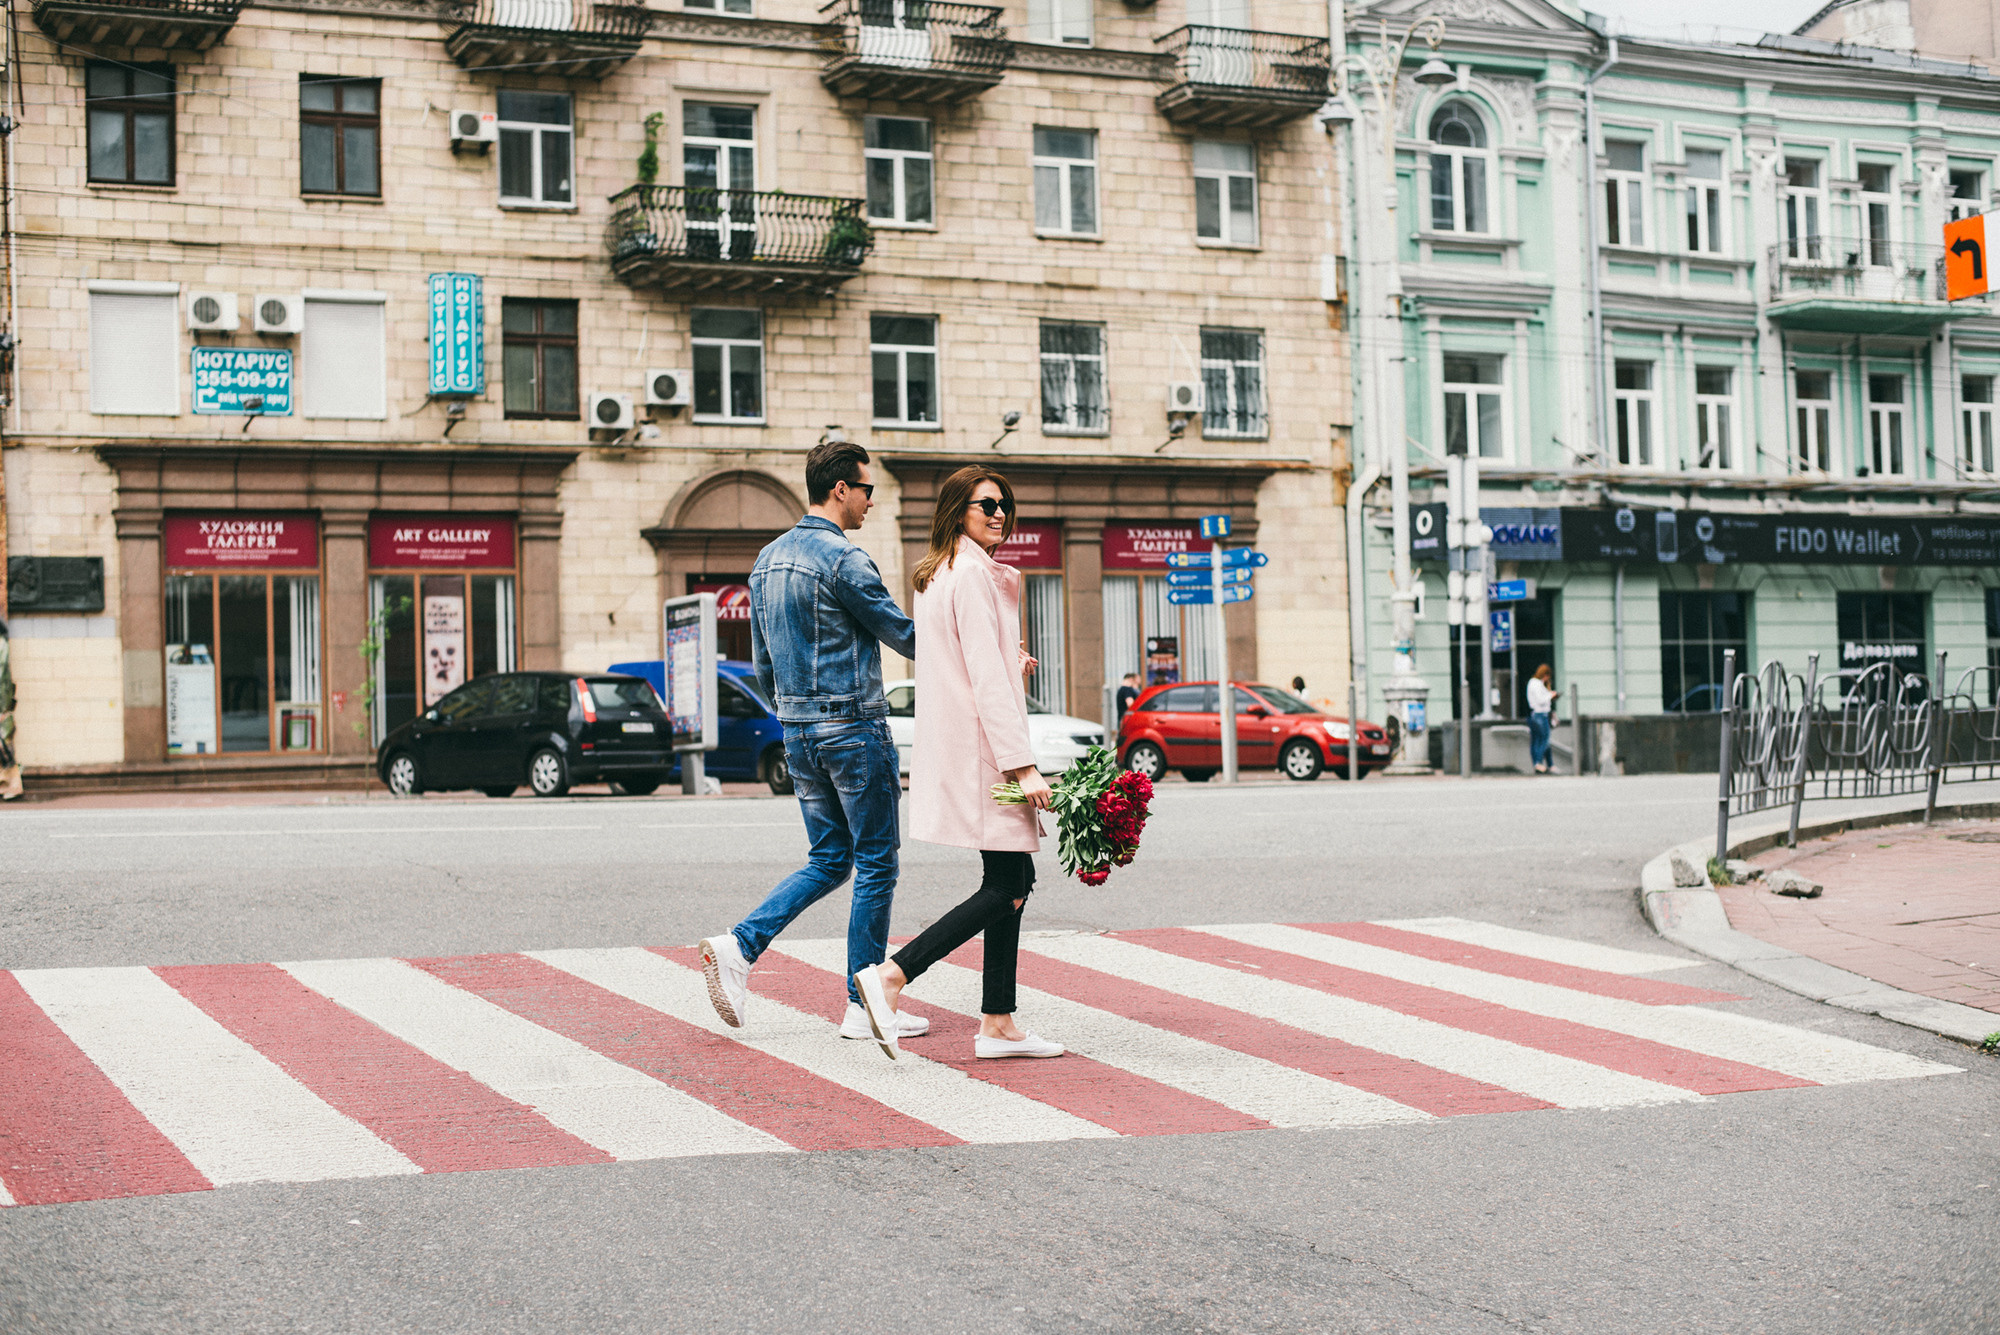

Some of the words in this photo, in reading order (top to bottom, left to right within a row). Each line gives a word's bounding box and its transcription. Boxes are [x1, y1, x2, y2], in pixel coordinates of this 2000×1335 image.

[433, 279, 446, 388] НОТАРІУС
[455, 279, 470, 388] НОТАРІУС
[196, 352, 288, 371] НОТАРІУС
[197, 370, 290, 389] 355-09-97
[199, 520, 284, 535] ХУДОЖНЯ
[392, 528, 424, 543] ART
[427, 528, 491, 543] GALLERY
[1127, 528, 1193, 541] ХУДОЖНЯ
[207, 534, 277, 549] ГАЛЕРЕЯ
[1132, 540, 1187, 553] ГАЛЕРЕЯ
[1775, 526, 1828, 553] FIDO
[1832, 527, 1901, 555] Wallet
[1843, 641, 1918, 661] Депозити
